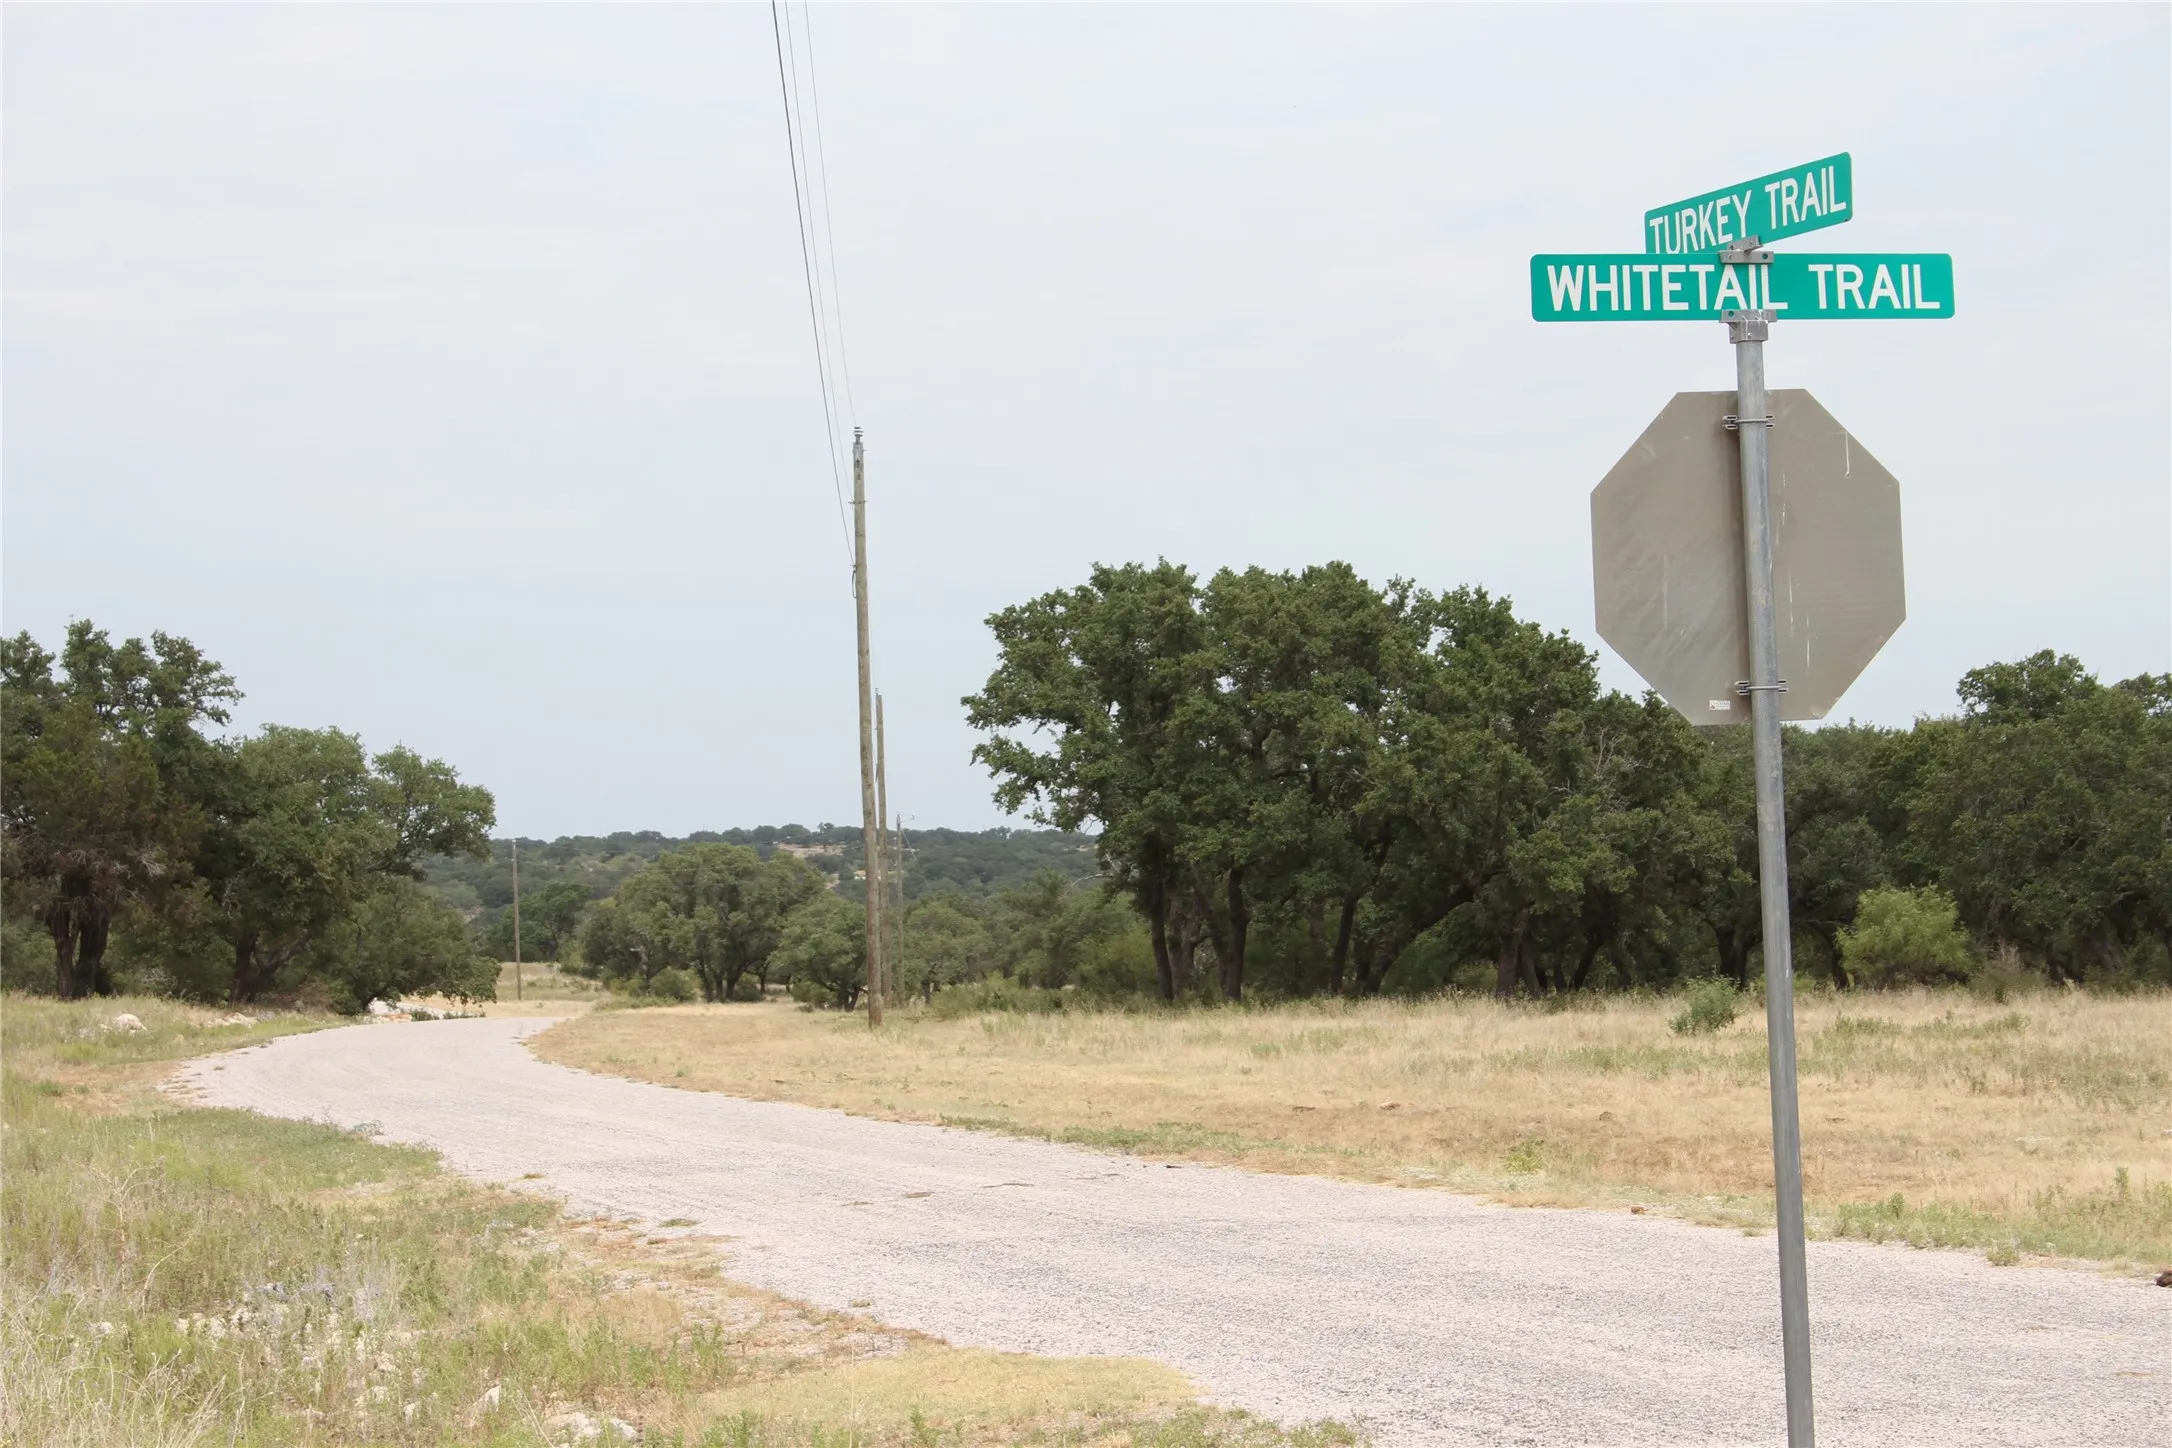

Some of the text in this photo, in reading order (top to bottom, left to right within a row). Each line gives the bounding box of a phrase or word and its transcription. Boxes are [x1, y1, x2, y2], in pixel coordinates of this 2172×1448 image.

[1649, 165, 1846, 254] TURKEY TRAIL
[1547, 264, 1940, 311] WHITETAIL TRAIL
